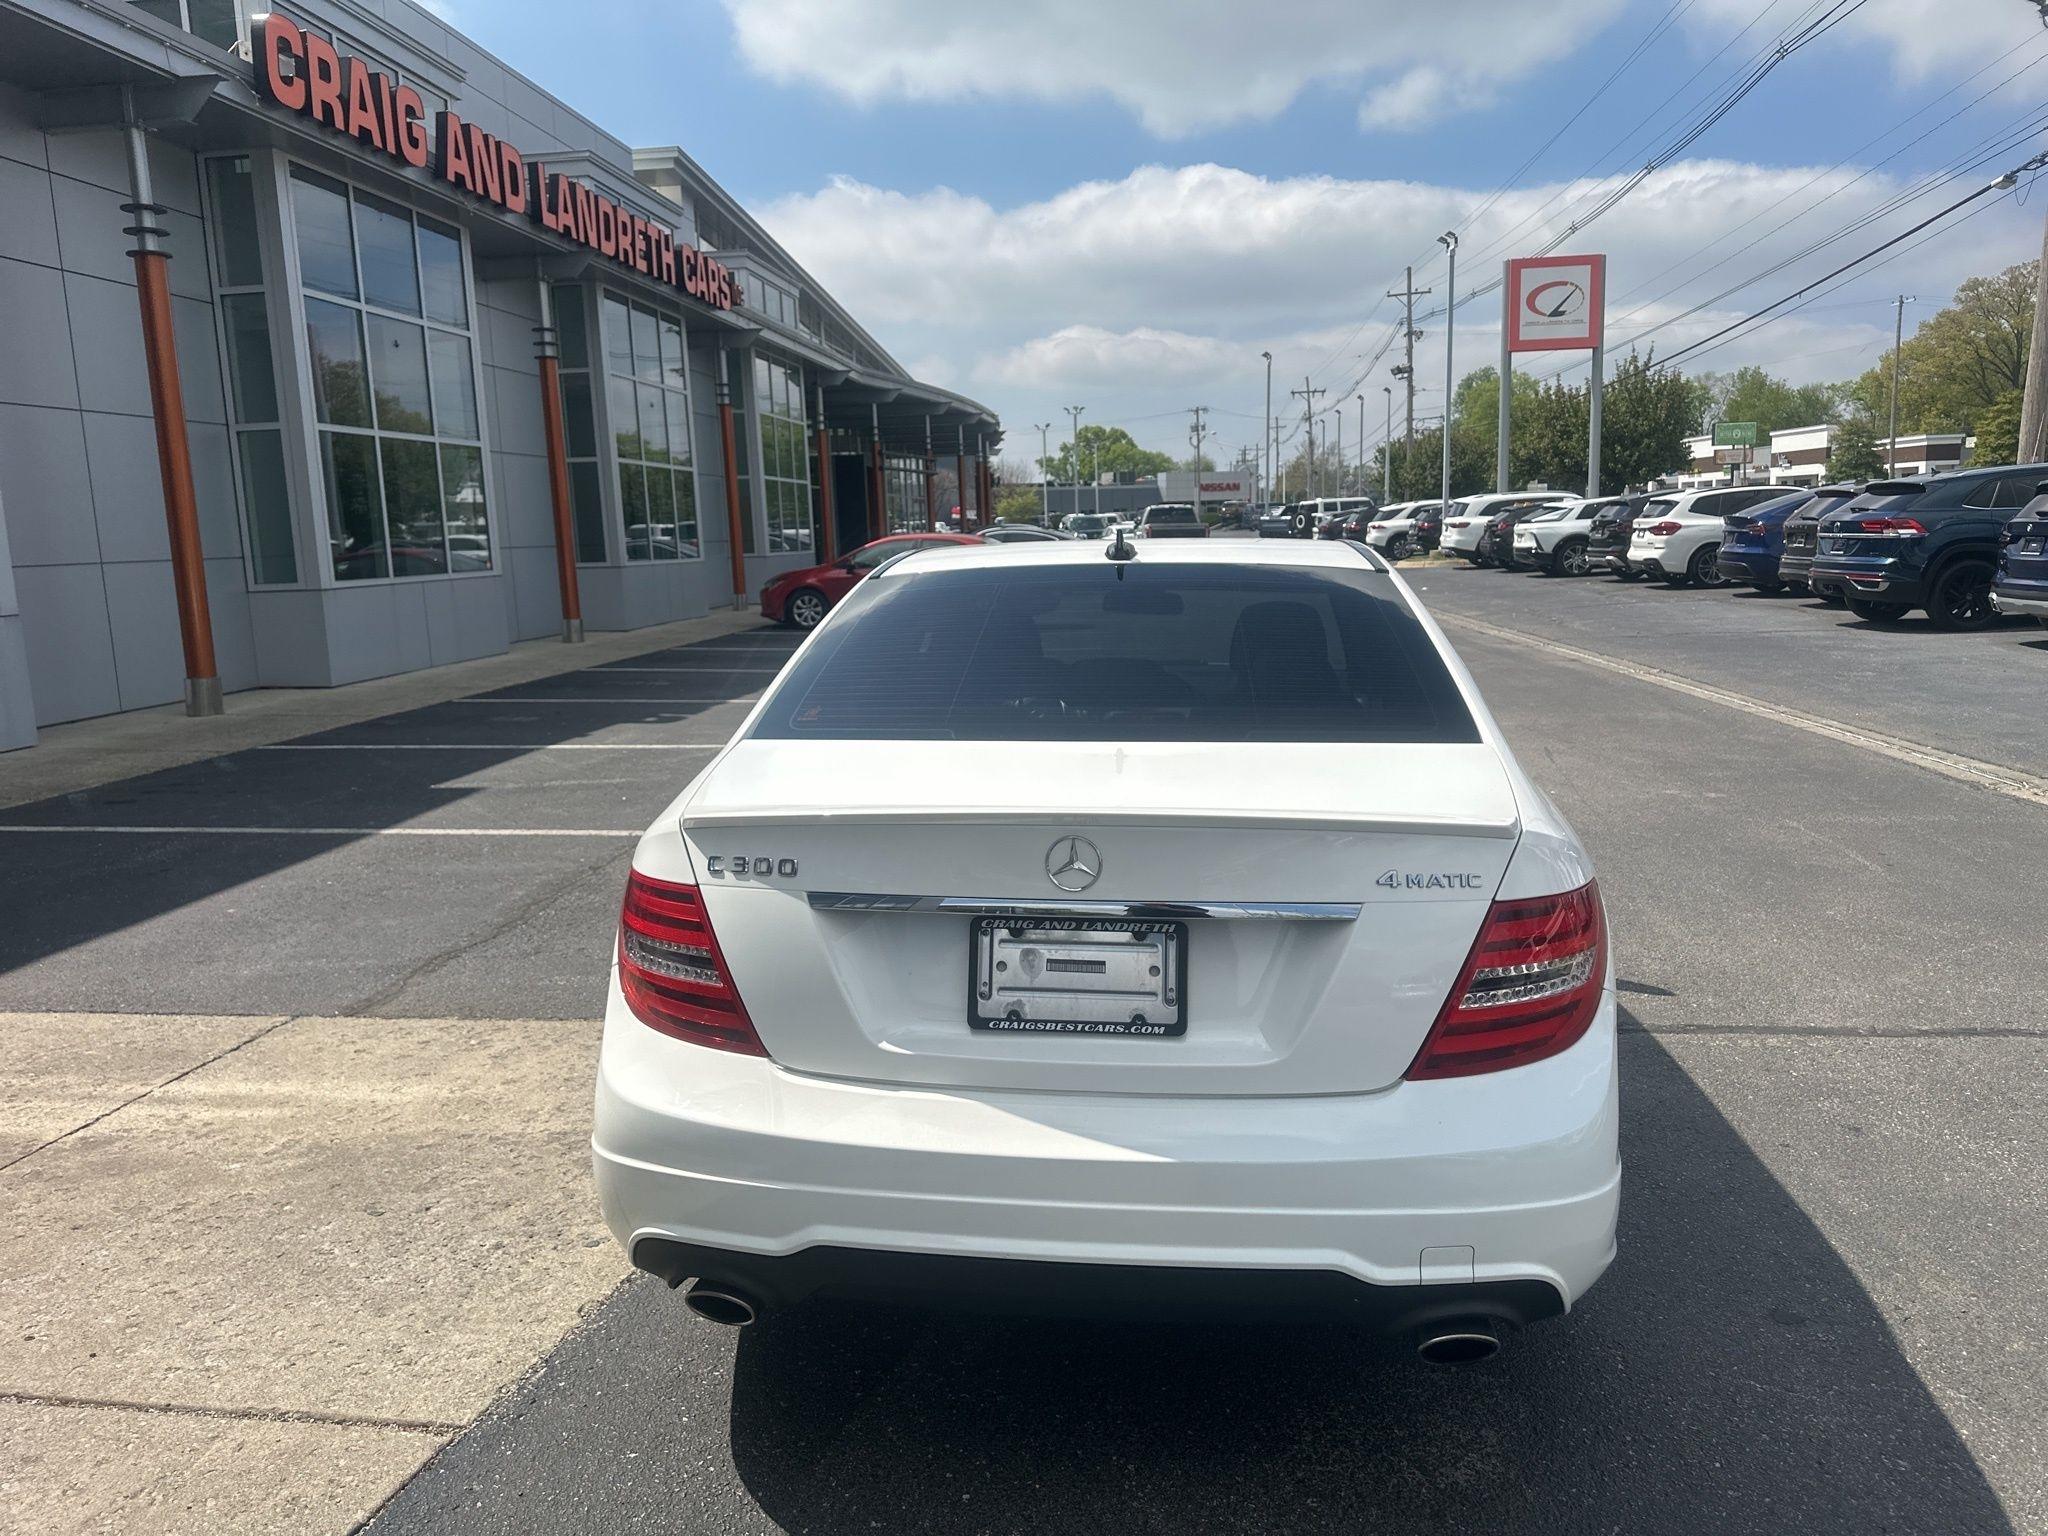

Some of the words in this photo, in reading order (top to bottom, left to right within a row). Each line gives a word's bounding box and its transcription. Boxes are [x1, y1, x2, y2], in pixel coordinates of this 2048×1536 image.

[262, 12, 429, 168] CRAIG
[446, 110, 526, 214] AND
[537, 162, 677, 286] LANDRETH
[681, 242, 732, 311] CARS
[1200, 482, 1240, 492] NISSAN
[981, 919, 1034, 929] CRAIG
[1039, 920, 1076, 931] AND
[1082, 921, 1176, 933] LANDRETH
[988, 1020, 1166, 1034] CRAIGSBESTCARS.COM
